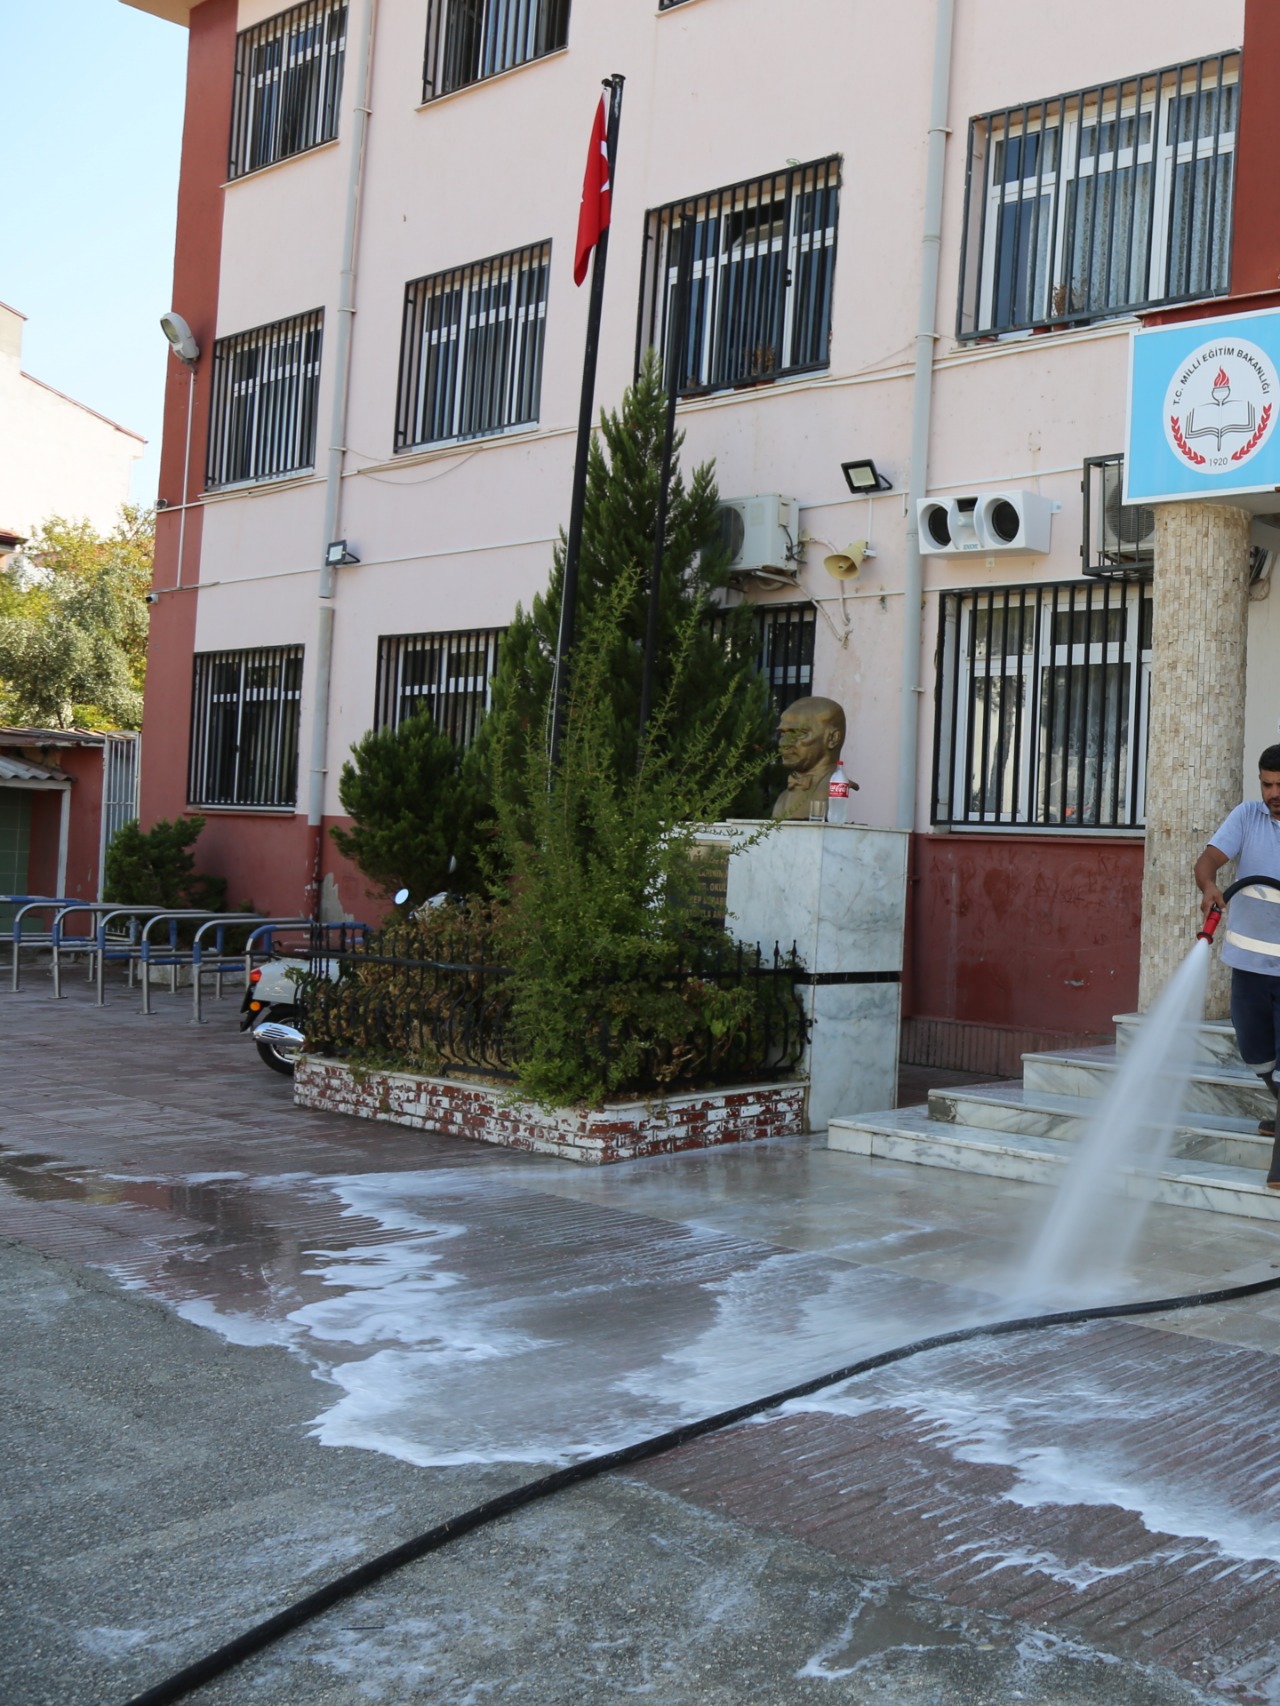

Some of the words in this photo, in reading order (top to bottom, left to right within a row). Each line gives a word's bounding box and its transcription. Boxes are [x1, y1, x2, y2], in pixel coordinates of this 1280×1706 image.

[1173, 388, 1184, 406] T.C.
[1180, 358, 1202, 386] MİLLİ
[1202, 345, 1235, 362] EĞİTİM
[1236, 349, 1270, 395] BAKANLIĞI
[1209, 457, 1228, 467] 1920
